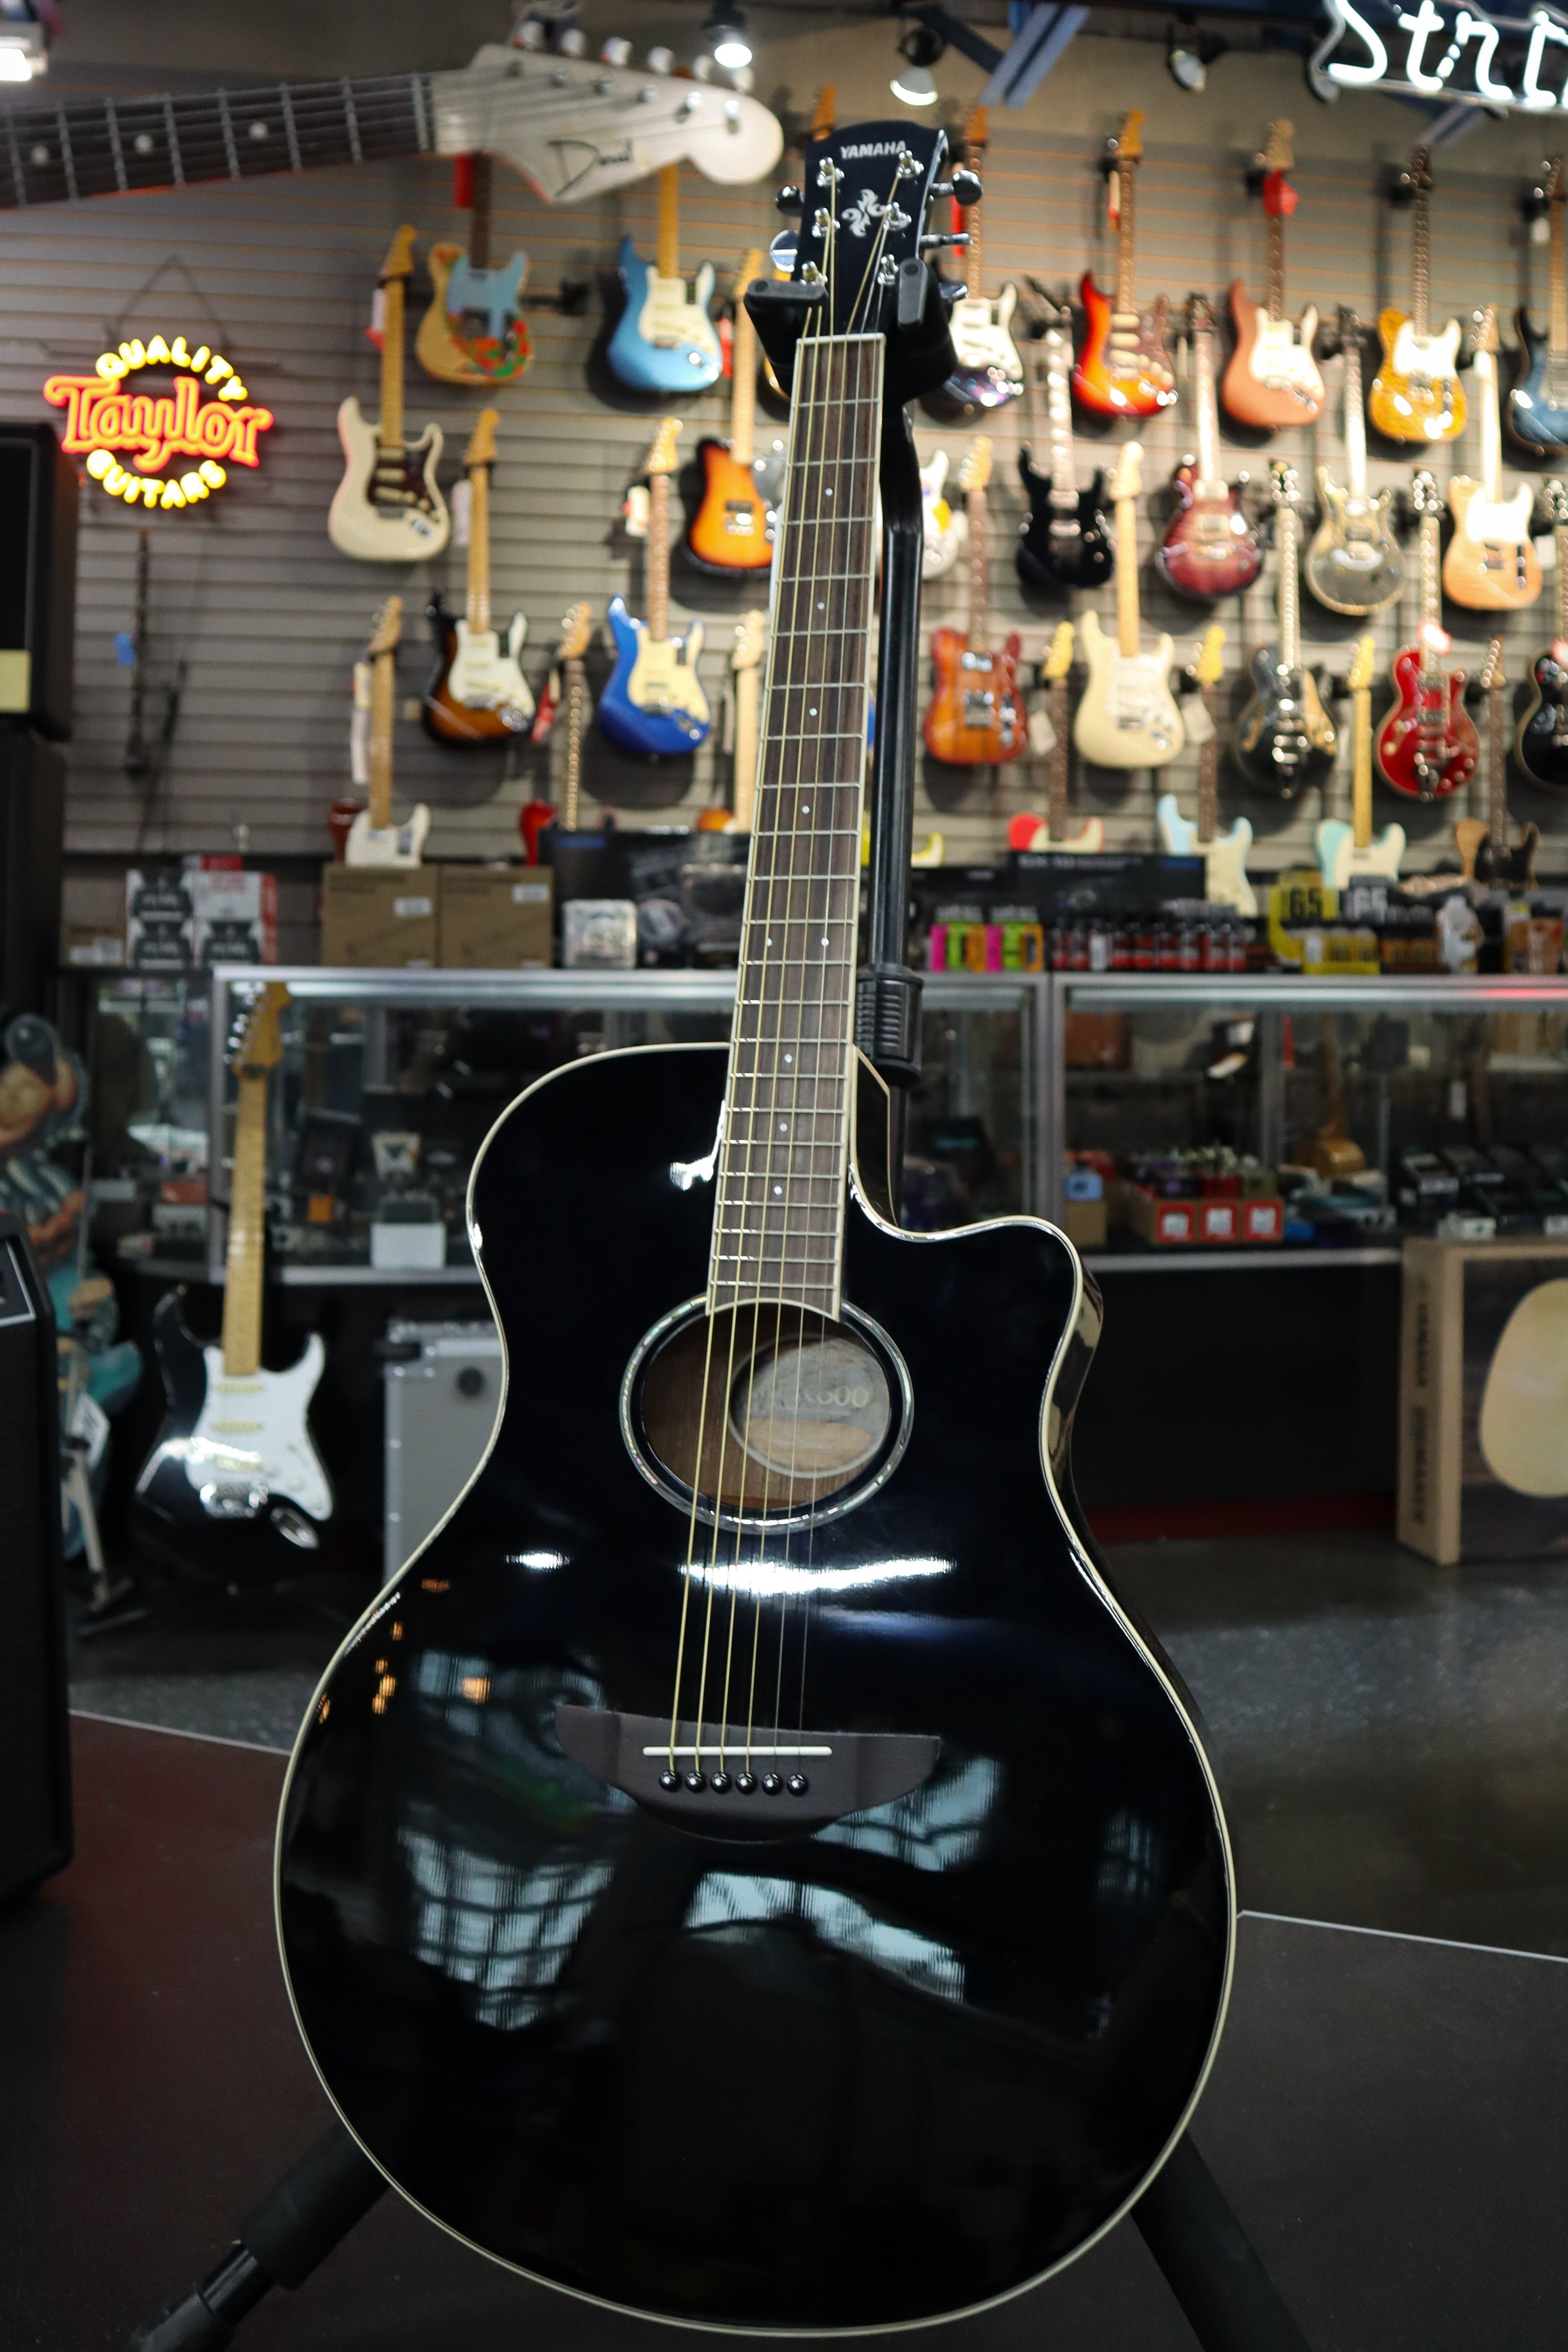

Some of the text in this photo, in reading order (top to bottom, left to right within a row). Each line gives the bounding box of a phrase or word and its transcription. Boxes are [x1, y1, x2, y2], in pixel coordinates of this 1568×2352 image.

[840, 140, 906, 159] YAMAHA
[95, 335, 248, 401] QUALITY
[43, 375, 274, 473] Taylor
